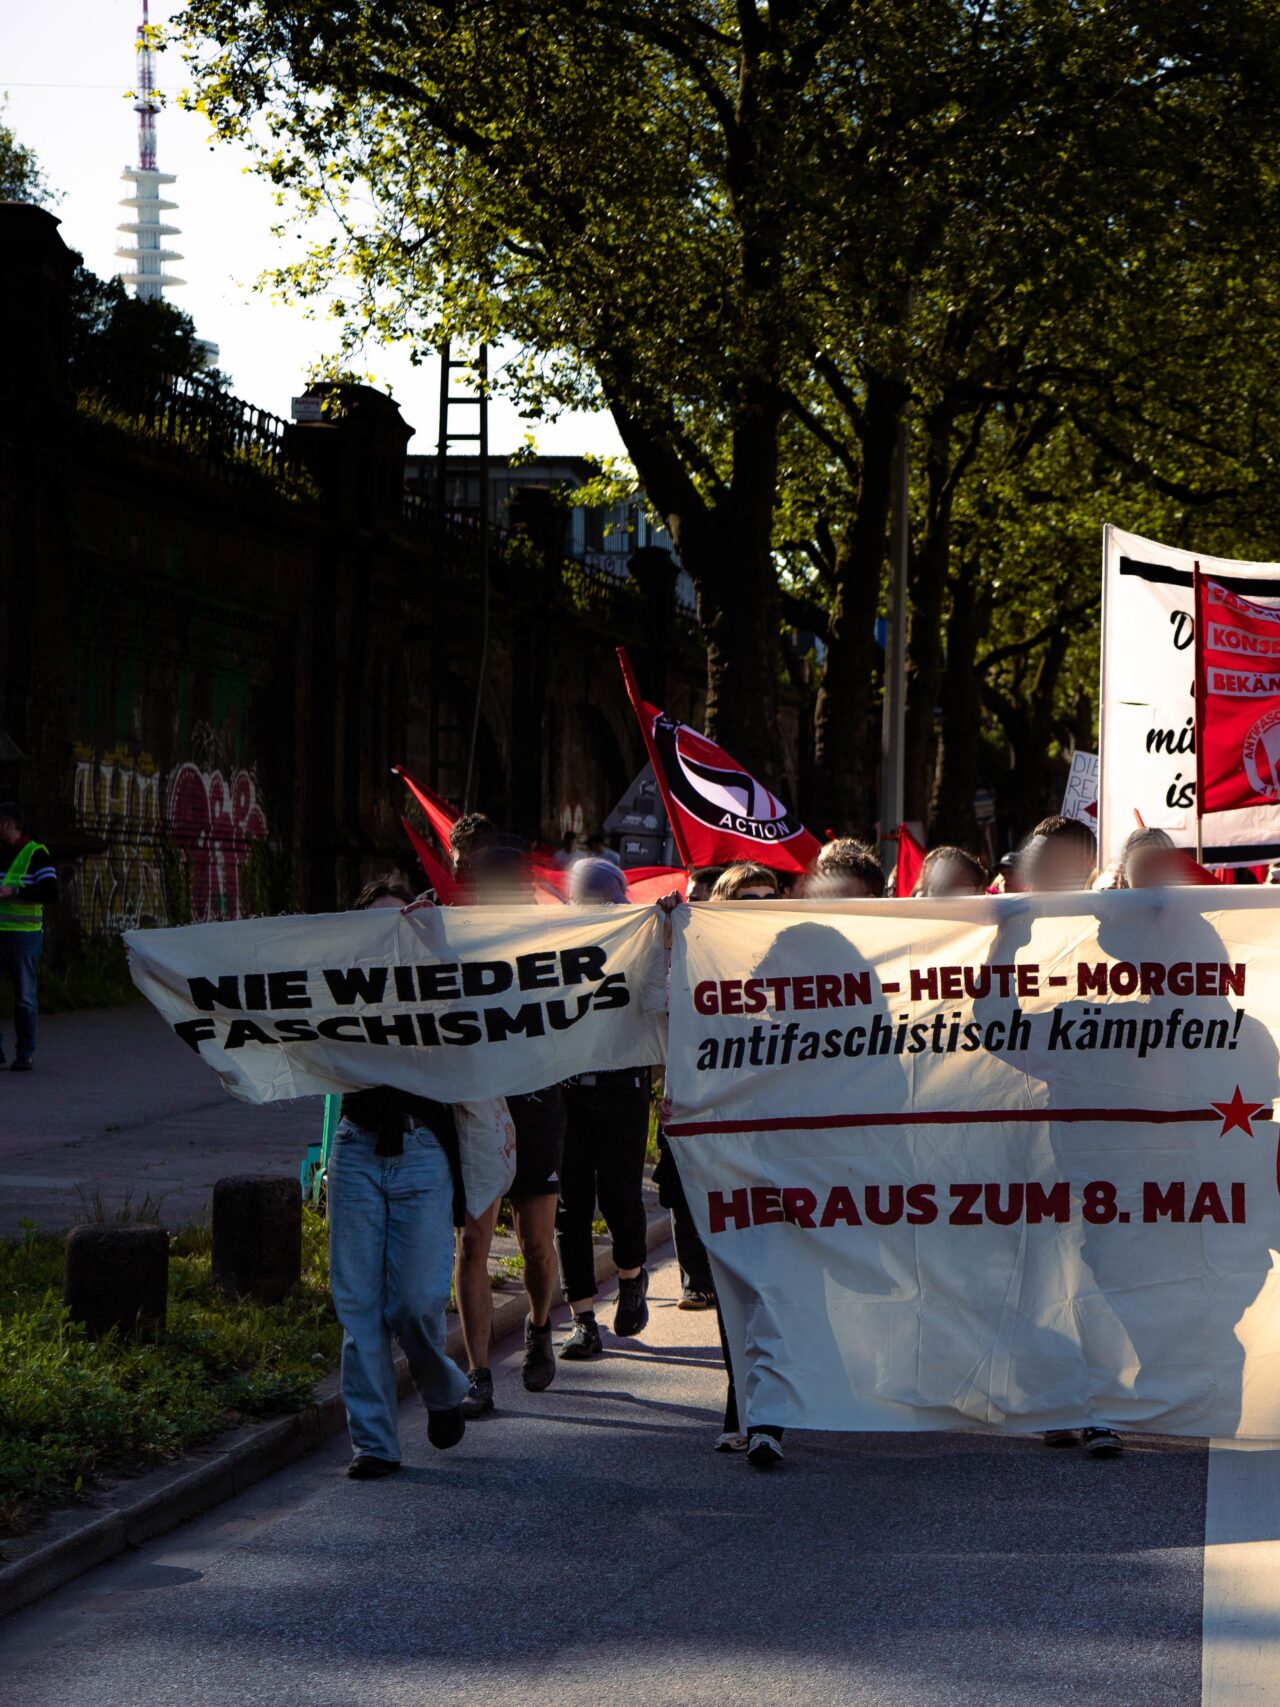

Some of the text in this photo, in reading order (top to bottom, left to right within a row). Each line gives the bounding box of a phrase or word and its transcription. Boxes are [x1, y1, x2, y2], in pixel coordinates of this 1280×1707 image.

[719, 813, 790, 840] ACTION
[187, 945, 609, 1012] NIE WIEDER
[694, 972, 872, 1016] GESTERN
[910, 964, 1039, 1001] HEUTE
[1077, 962, 1247, 997] MORGEN
[174, 972, 631, 1053] FASCHISMUS
[697, 1008, 1244, 1071] antifaschistisch kämpfen!
[707, 1181, 1247, 1234] HERAUS ZUM 8. MAI
